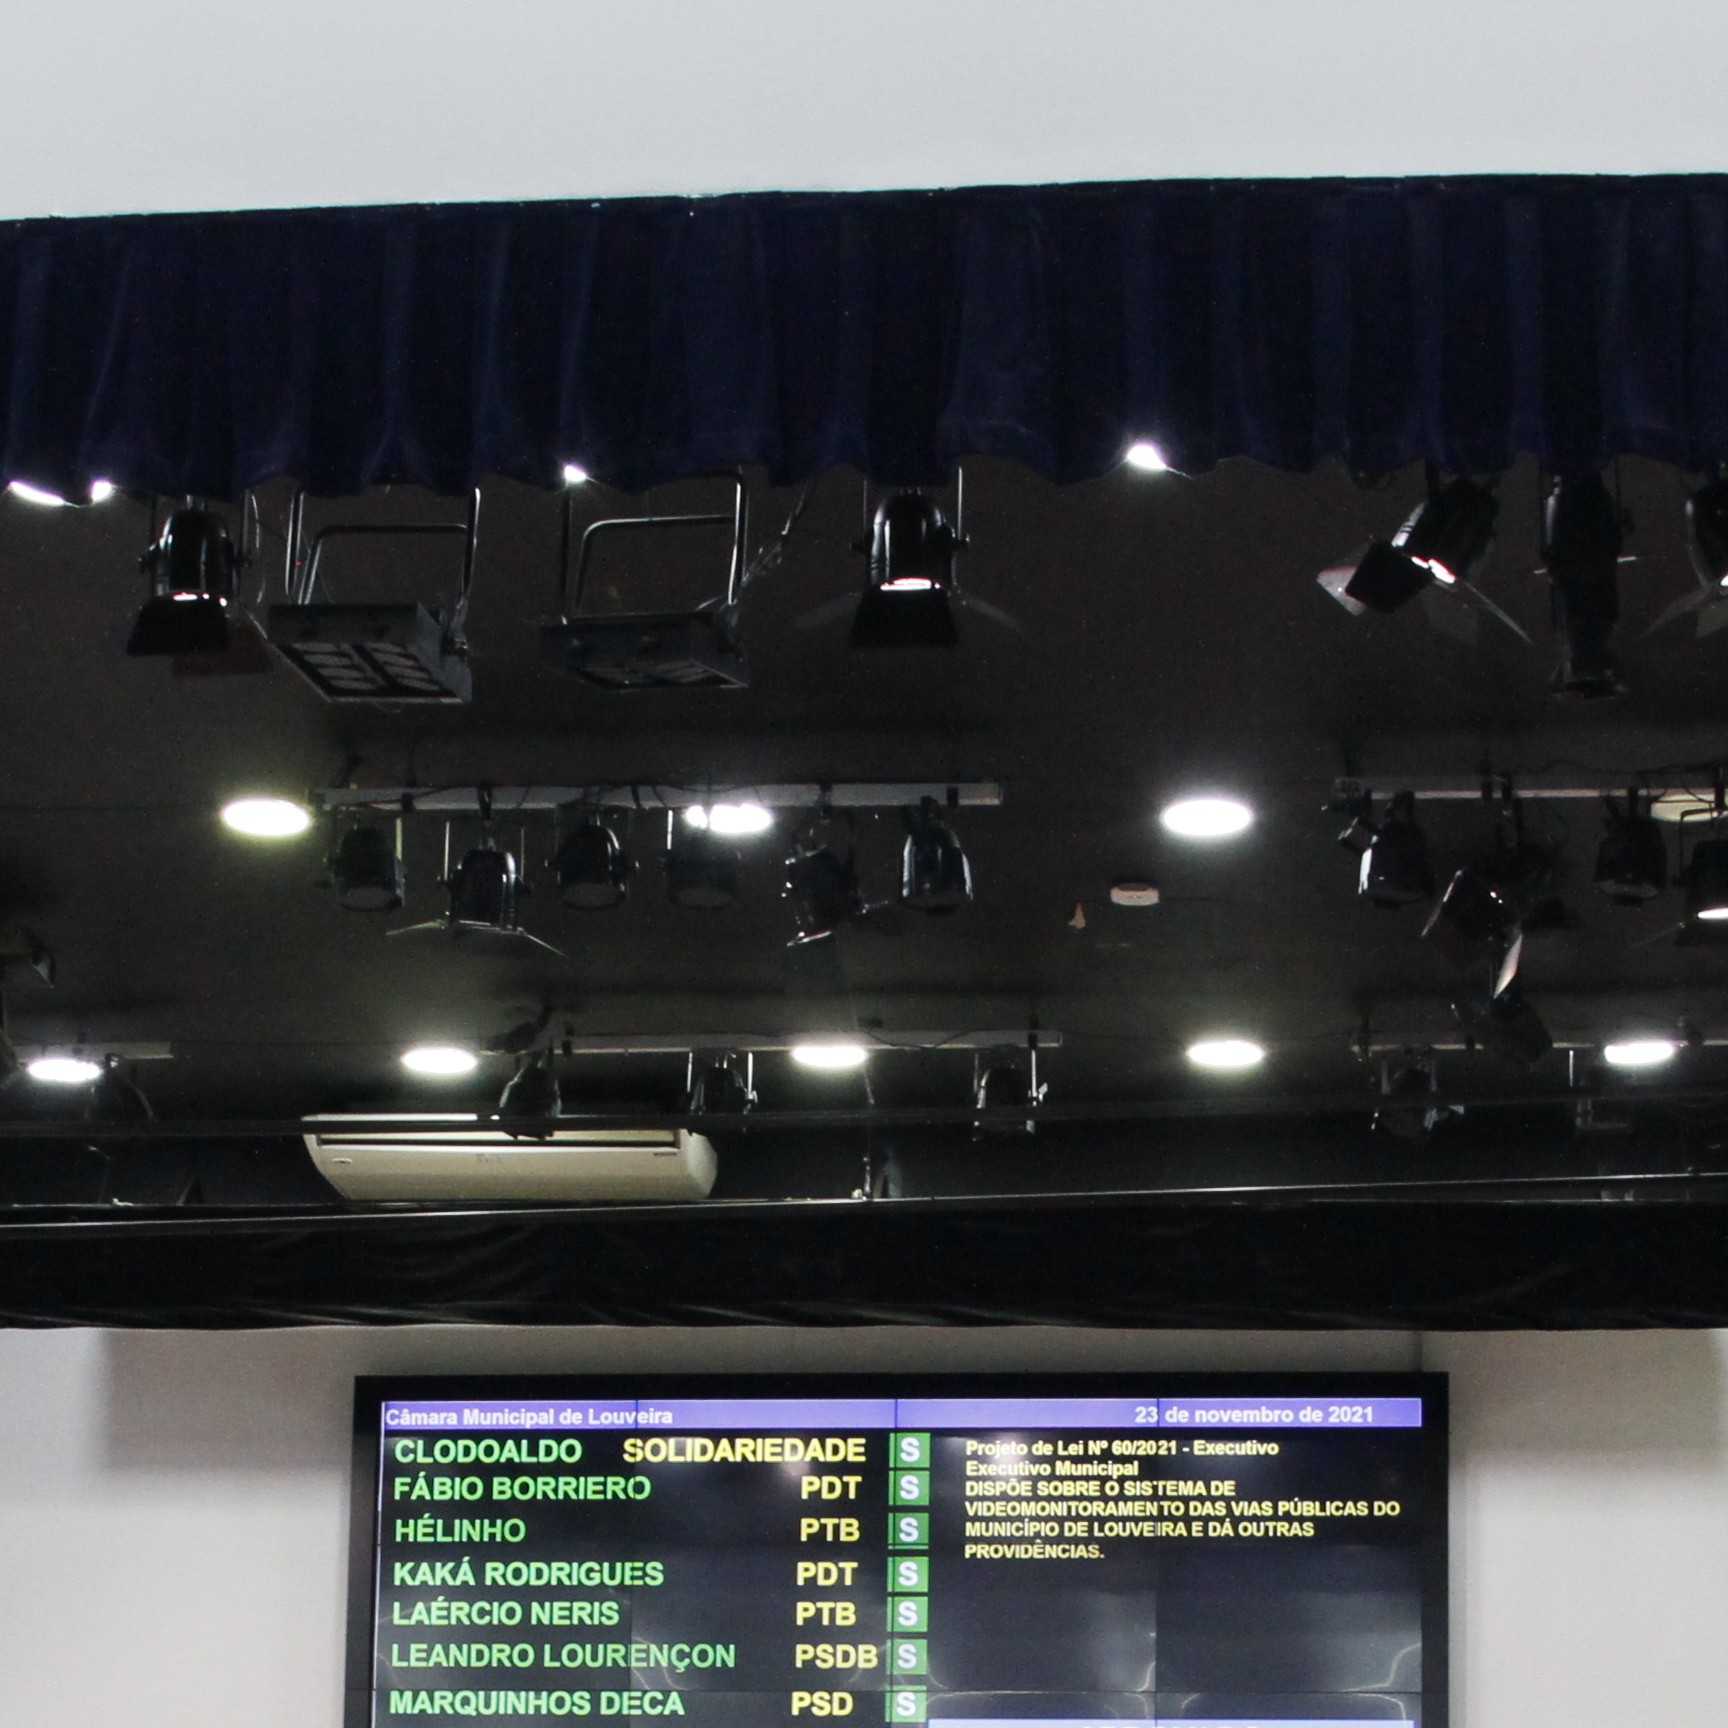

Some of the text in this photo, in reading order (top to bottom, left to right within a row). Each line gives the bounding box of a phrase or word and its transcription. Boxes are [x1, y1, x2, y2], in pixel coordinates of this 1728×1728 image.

[386, 1407, 672, 1428] Câmara Municipal de Louveira
[1135, 1405, 1374, 1423] 23 de novembro de 2021
[395, 1437, 919, 1464] CLODOALDO SOLIDARIEDADE S
[966, 1440, 1026, 1459] Projeto
[1033, 1439, 1053, 1455] de
[1058, 1440, 1083, 1455] Lei
[1113, 1439, 1177, 1456] 60/2021
[1194, 1440, 1279, 1456] Executivo
[966, 1460, 1139, 1479] Executivo Municipal
[395, 1471, 919, 1500] FÁBIO BORRIERO PDT S
[965, 1478, 1235, 1496] DISPÕE SOBRE O SISTEMA DE
[965, 1496, 1400, 1516] VIDEOMONITORAMENTO DAS VIAS PÚBLICAS DO
[395, 1513, 918, 1542] HÉLINHO PTB S
[965, 1517, 1314, 1537] MUNICÍPIO DE LOUVEIRA E DÁ OUTRAS
[965, 1539, 1105, 1559] PROVIDÊNCIAS.
[394, 1555, 918, 1586] KAKÁ RODRIGUES PDT S
[393, 1596, 917, 1626] LAÉRCIO NERIS PTB S
[392, 1643, 917, 1672] LEANDRO LOURENÇON PSDB S
[390, 1691, 916, 1717] MARQUINHOS DECA PSD S
